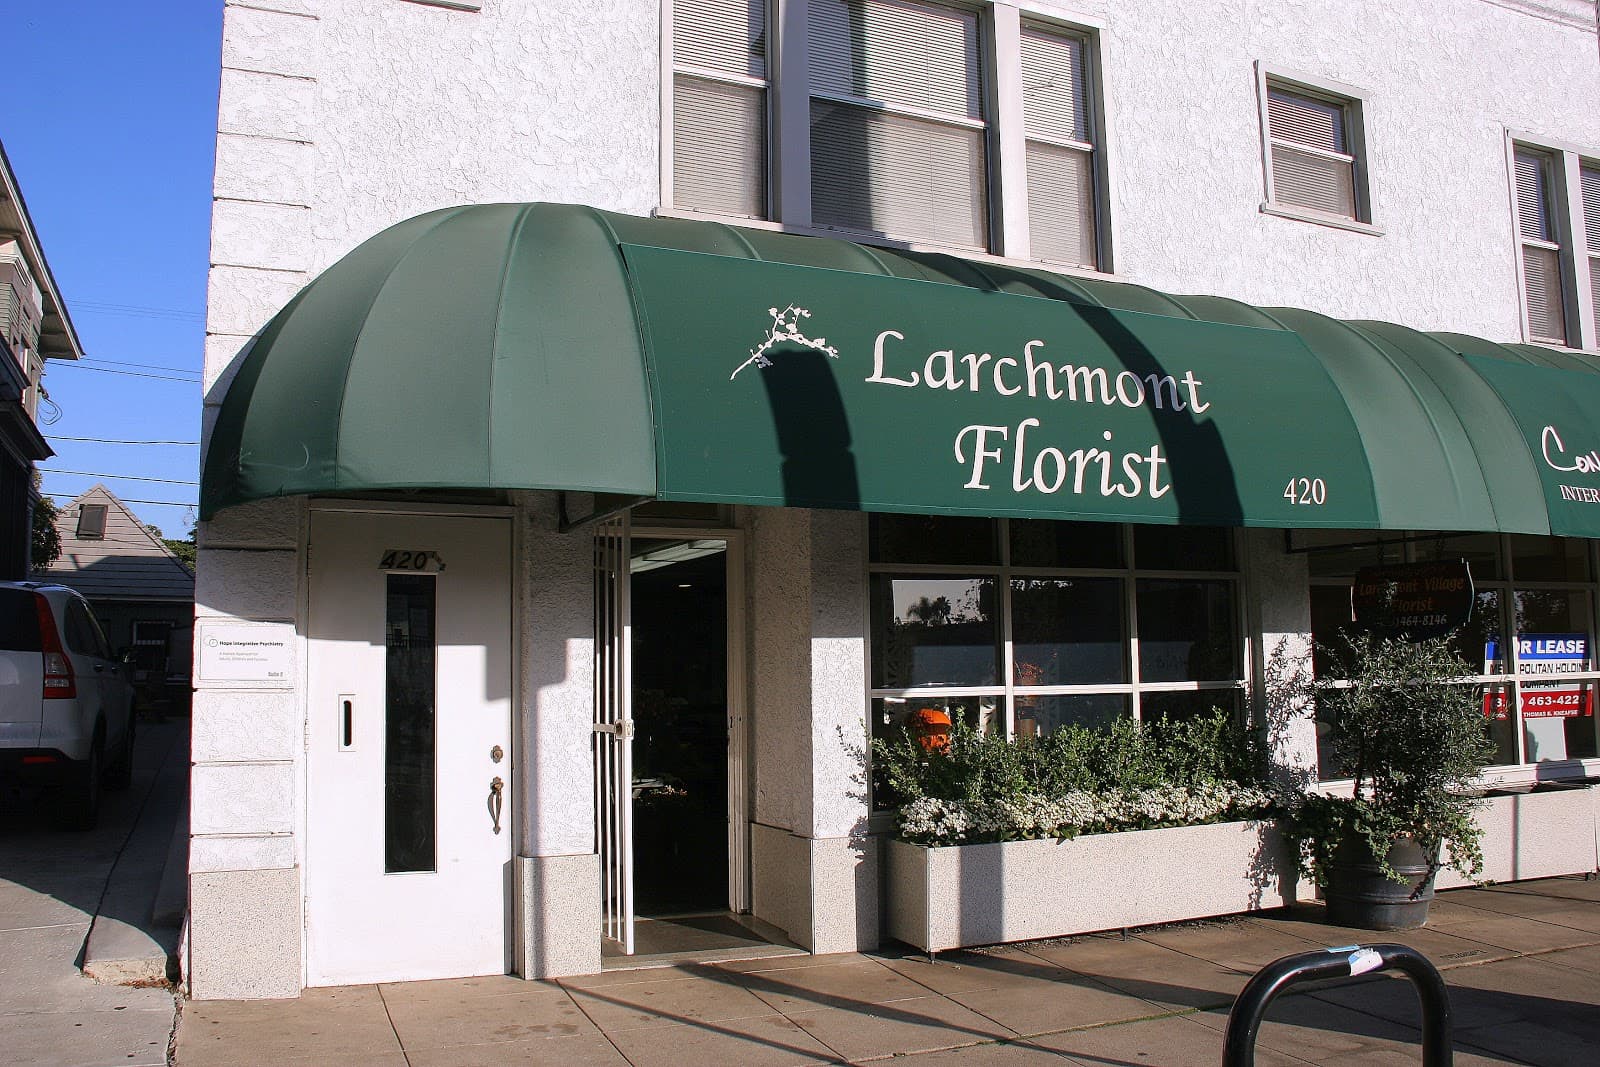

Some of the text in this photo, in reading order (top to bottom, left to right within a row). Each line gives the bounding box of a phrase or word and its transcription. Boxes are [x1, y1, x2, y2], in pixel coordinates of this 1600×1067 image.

[864, 330, 1210, 414] Larchmont
[953, 418, 1171, 499] Florist
[1283, 477, 1326, 505] 420
[1424, 575, 1465, 592] Village
[1536, 639, 1585, 654] LEASE
[1490, 663, 1553, 675] MEPOLITAN
